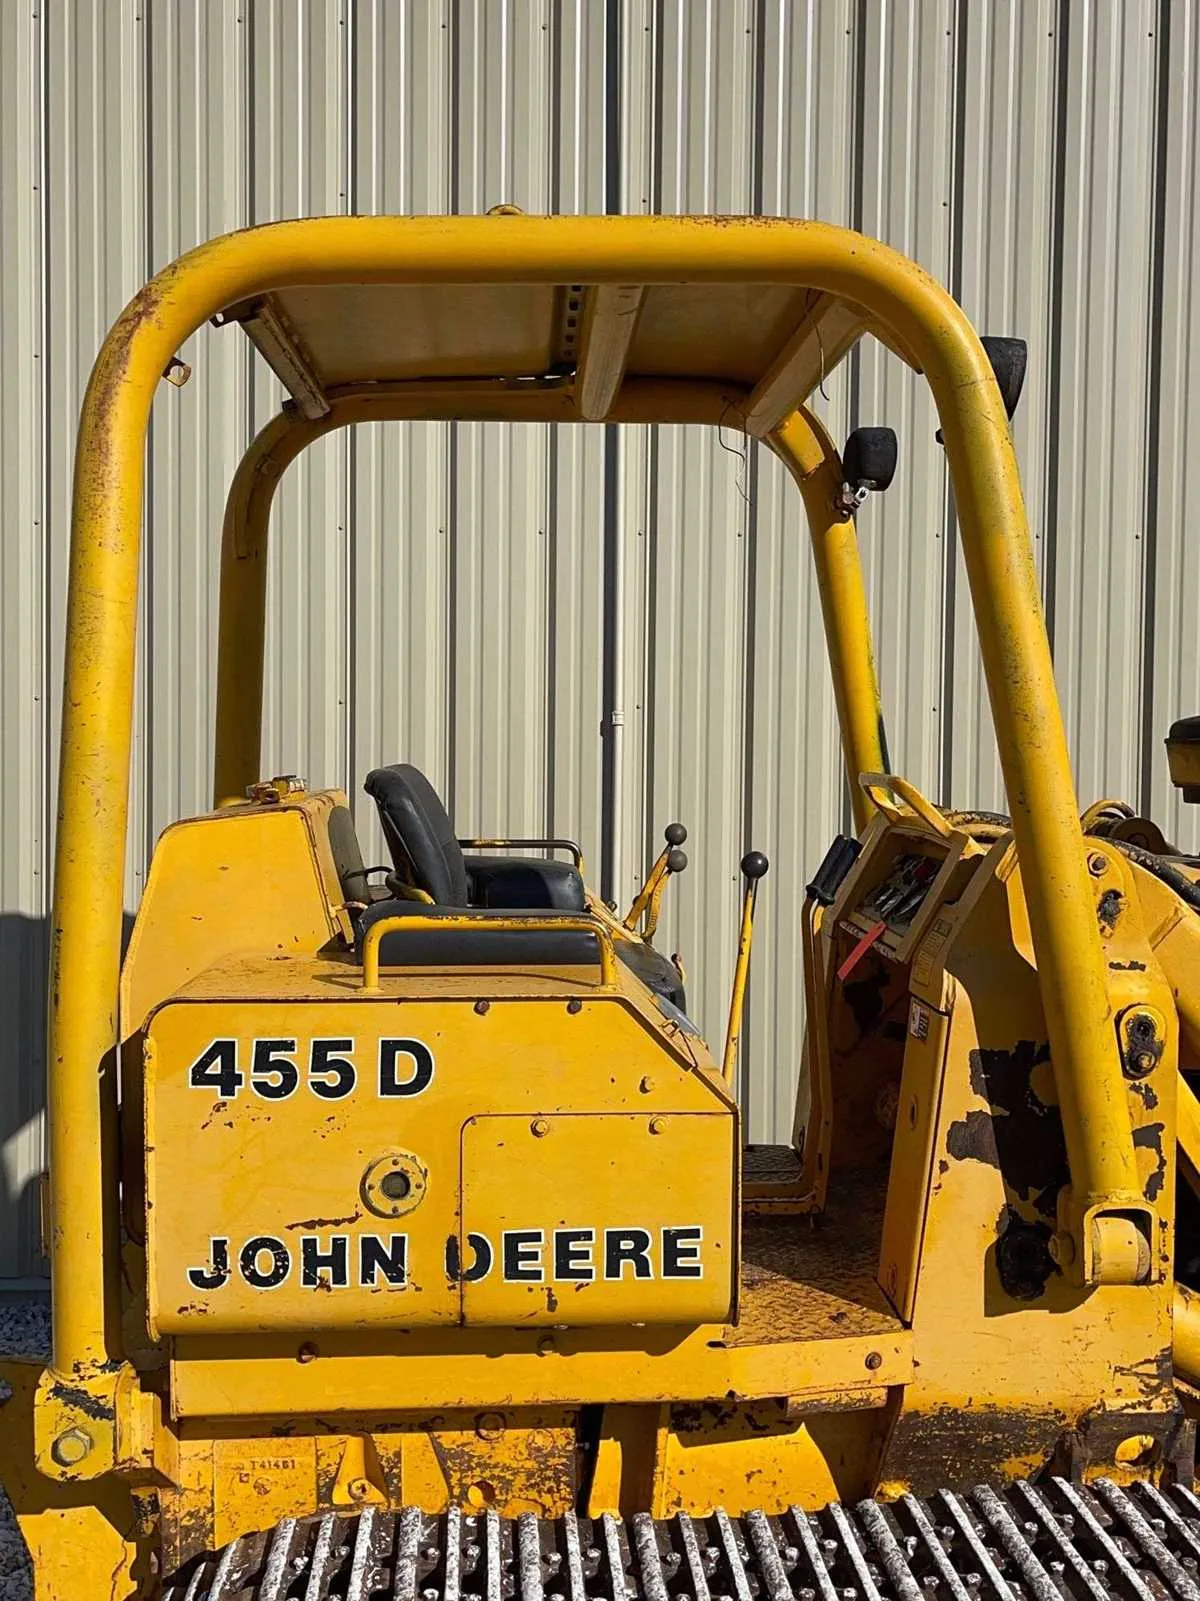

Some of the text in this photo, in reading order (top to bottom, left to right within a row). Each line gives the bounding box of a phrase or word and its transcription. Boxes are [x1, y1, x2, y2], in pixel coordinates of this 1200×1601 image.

[190, 1037, 434, 1100] 455 D
[187, 1225, 703, 1290] JOHN DEERE
